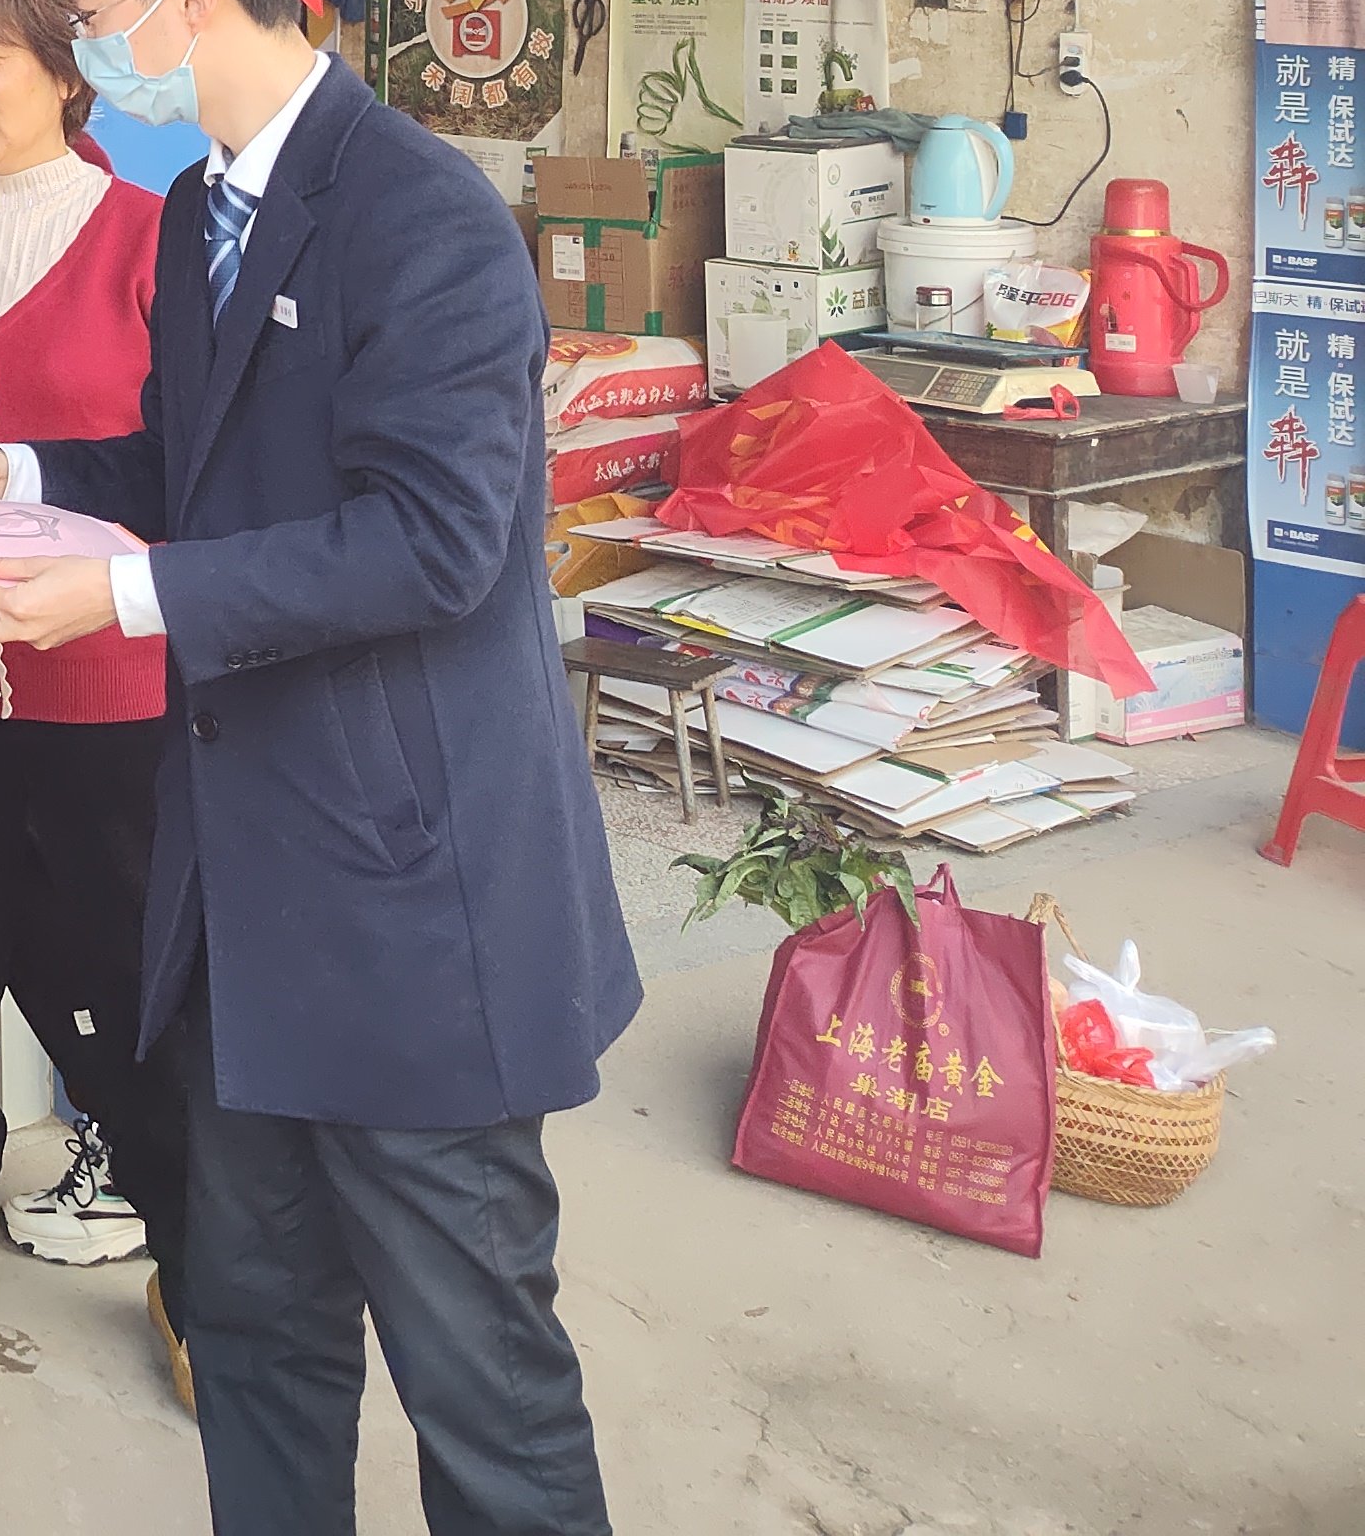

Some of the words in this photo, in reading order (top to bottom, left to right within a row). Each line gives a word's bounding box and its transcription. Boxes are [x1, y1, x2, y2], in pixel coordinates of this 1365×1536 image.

[1287, 255, 1318, 267] BASF
[1253, 291, 1300, 307] 巴斯夫
[816, 1014, 1005, 1099] 上海老庙黄金
[848, 1071, 954, 1122] 巢湖店
